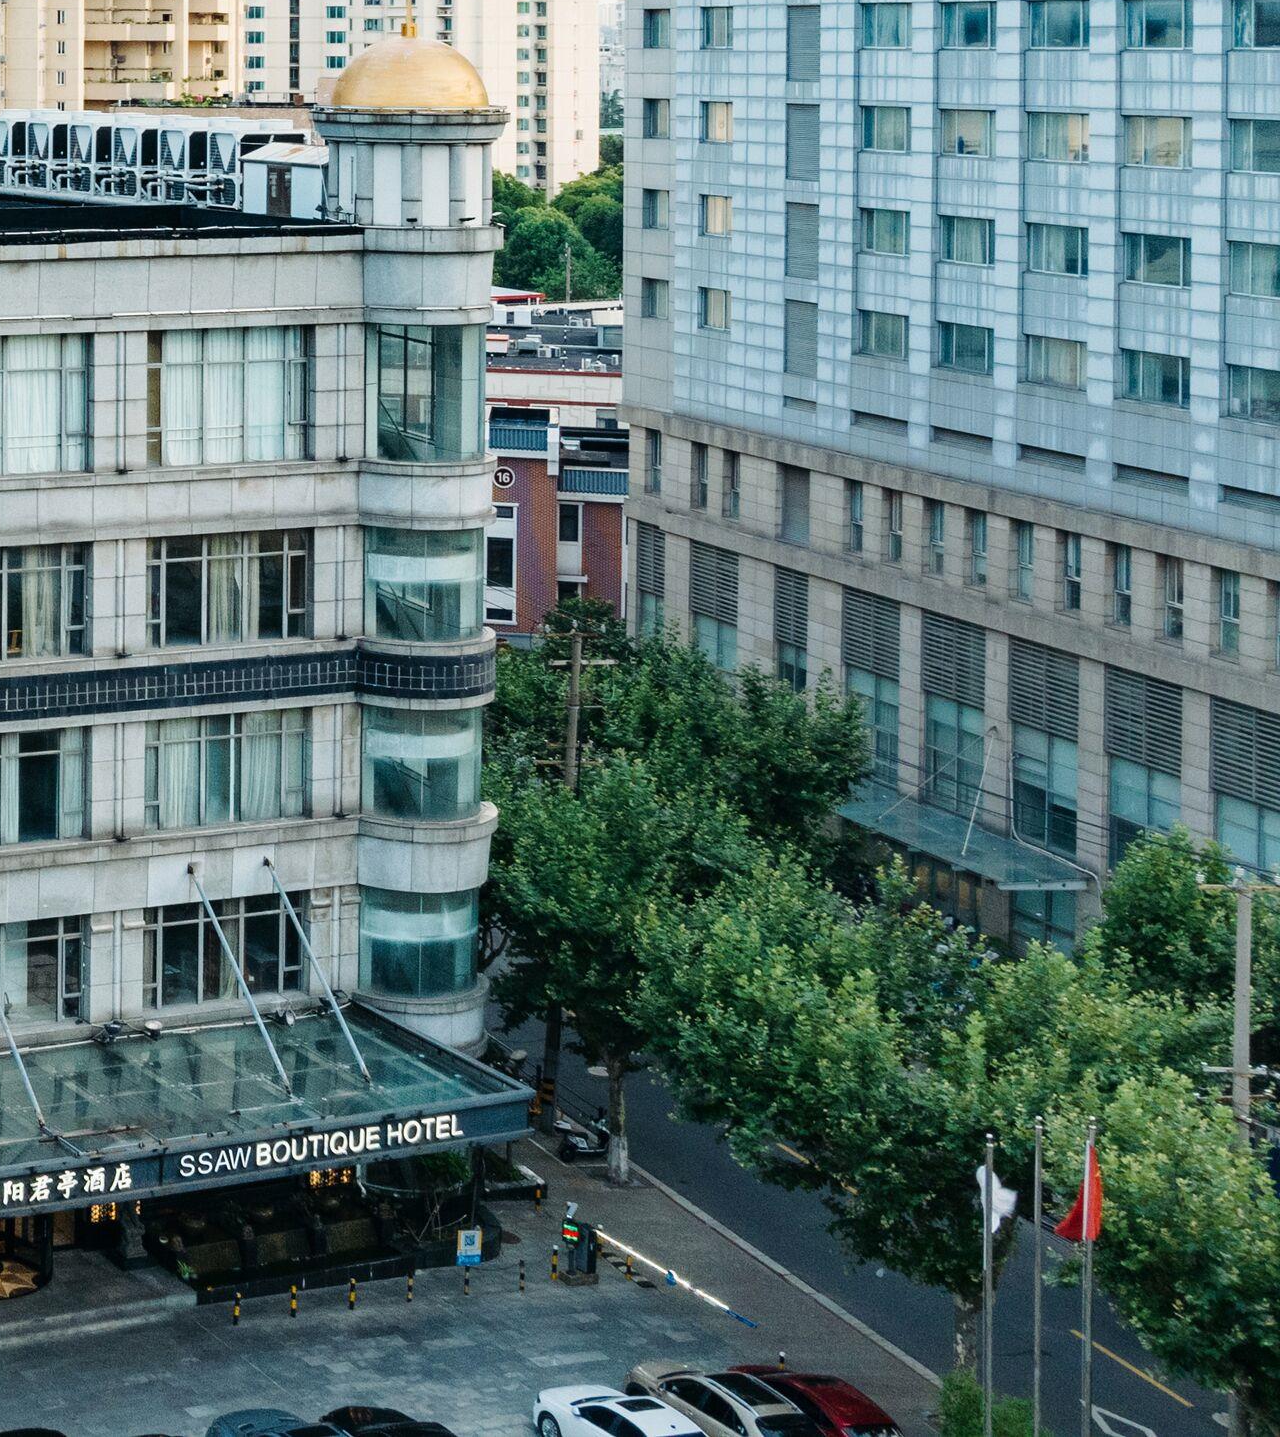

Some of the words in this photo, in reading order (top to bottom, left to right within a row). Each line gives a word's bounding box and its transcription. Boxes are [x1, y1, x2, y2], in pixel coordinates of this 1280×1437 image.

[497, 472, 510, 483] 16
[179, 1146, 252, 1178] SSAW
[256, 1125, 381, 1167] BOUTIQUE
[387, 1114, 464, 1146] HOTEL
